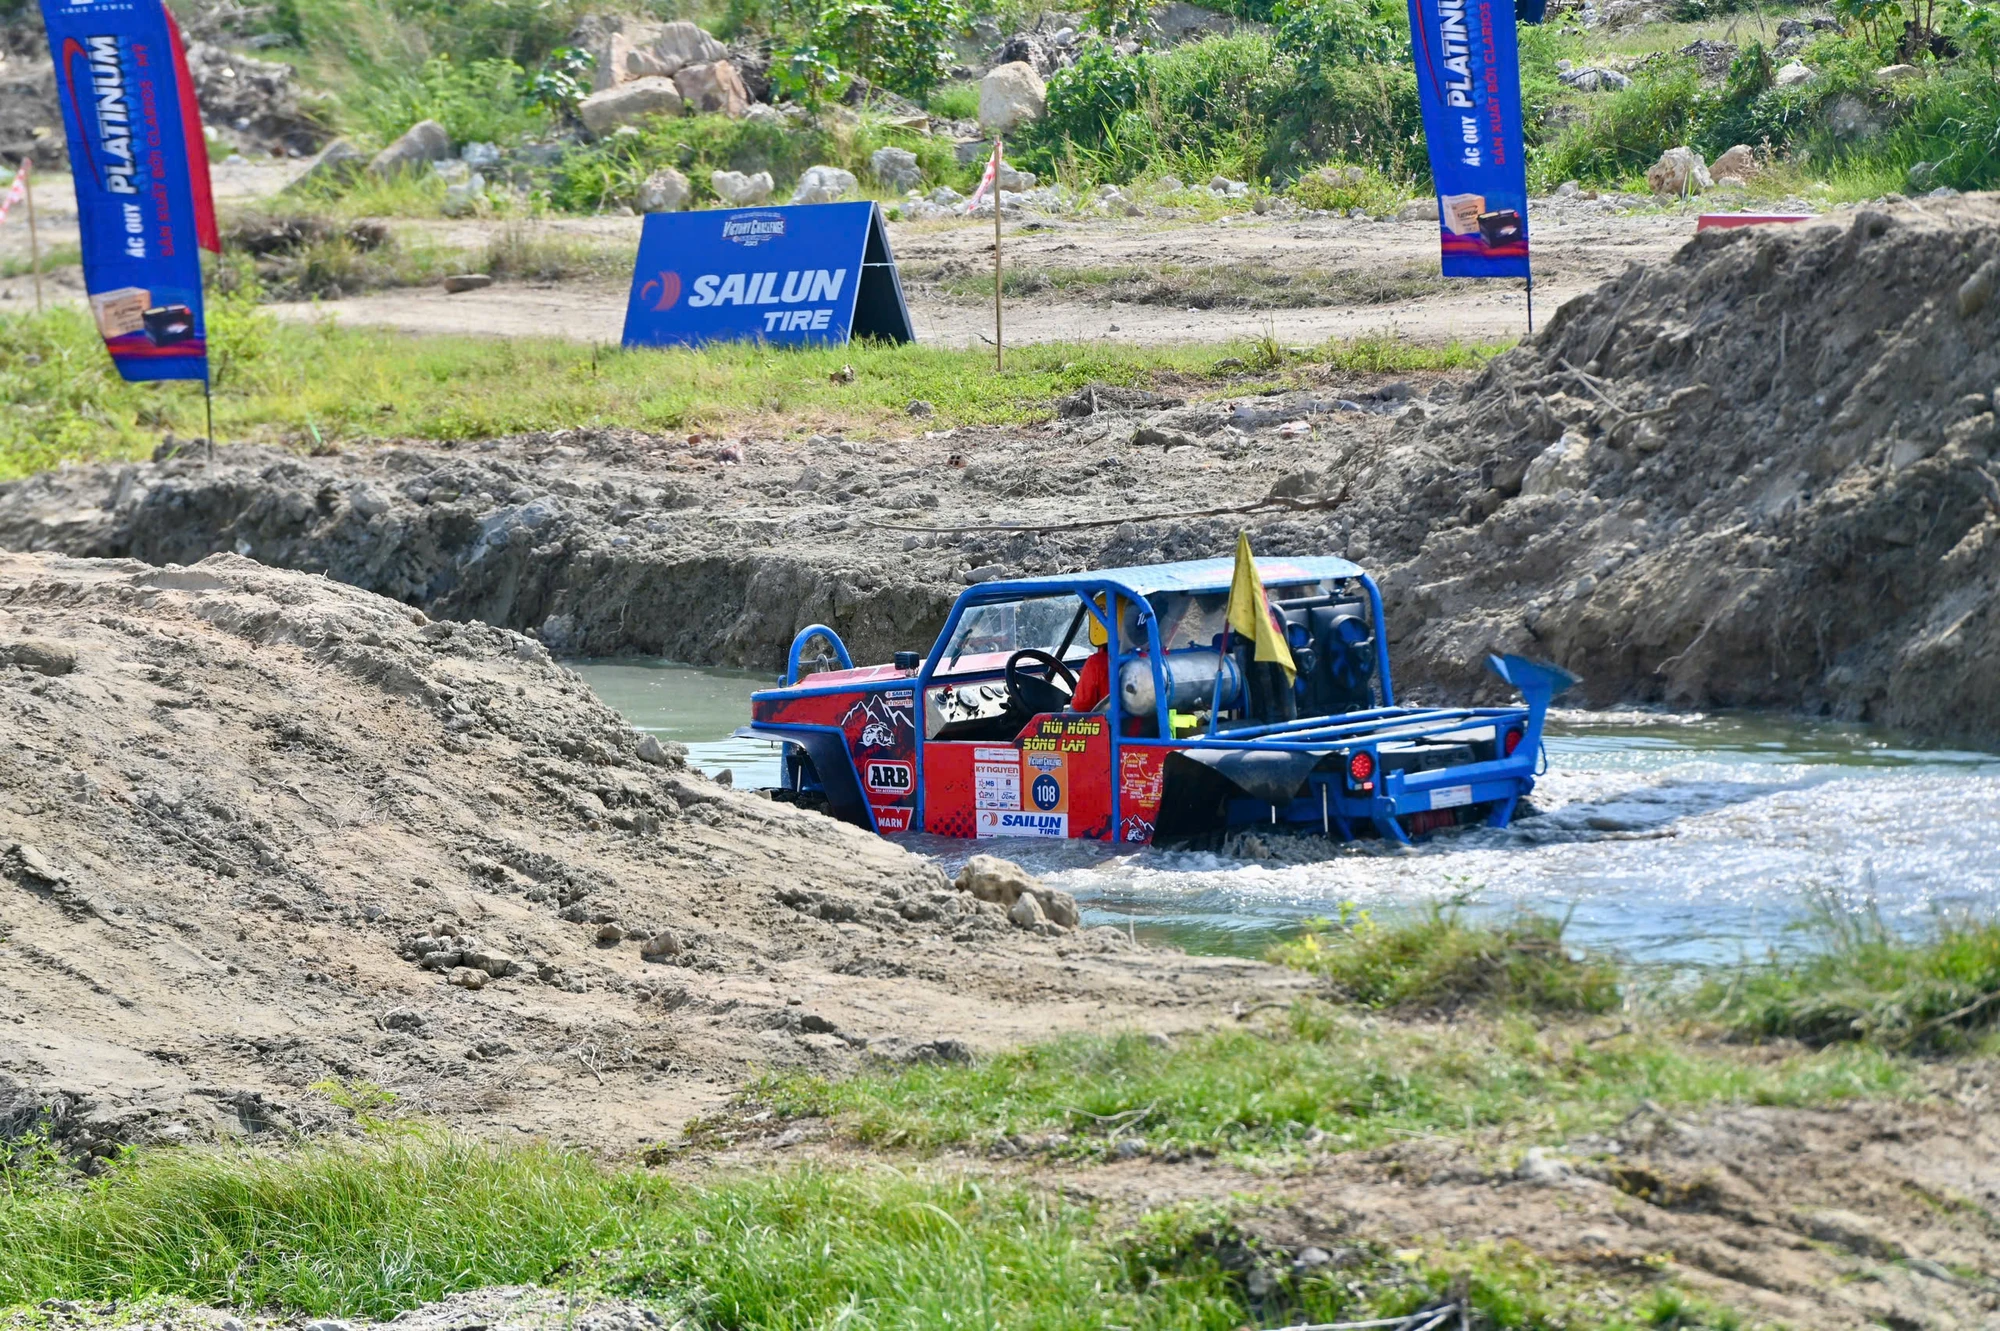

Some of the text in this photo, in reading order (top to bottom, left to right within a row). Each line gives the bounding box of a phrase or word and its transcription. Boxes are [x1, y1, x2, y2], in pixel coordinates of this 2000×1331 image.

[60, 4, 134, 14] TRUE POWER
[1479, 3, 1497, 64] CLARIOS
[86, 35, 138, 194] PLATINUM
[140, 81, 161, 147] CLARIOS
[1461, 115, 1479, 144] QUY
[123, 202, 144, 234] QUY
[687, 268, 847, 308] SAILUN
[763, 309, 833, 333] TIRE
[1042, 717, 1101, 736] NÚI HỒNG
[1022, 735, 1086, 752] SÔNG LAM
[871, 766, 909, 787] ARB
[1001, 791, 1016, 800] Ford
[1036, 785, 1056, 803] 108
[878, 817, 903, 828] WARN
[1002, 814, 1062, 828] SAILUN
[1038, 828, 1060, 836] TIRE
